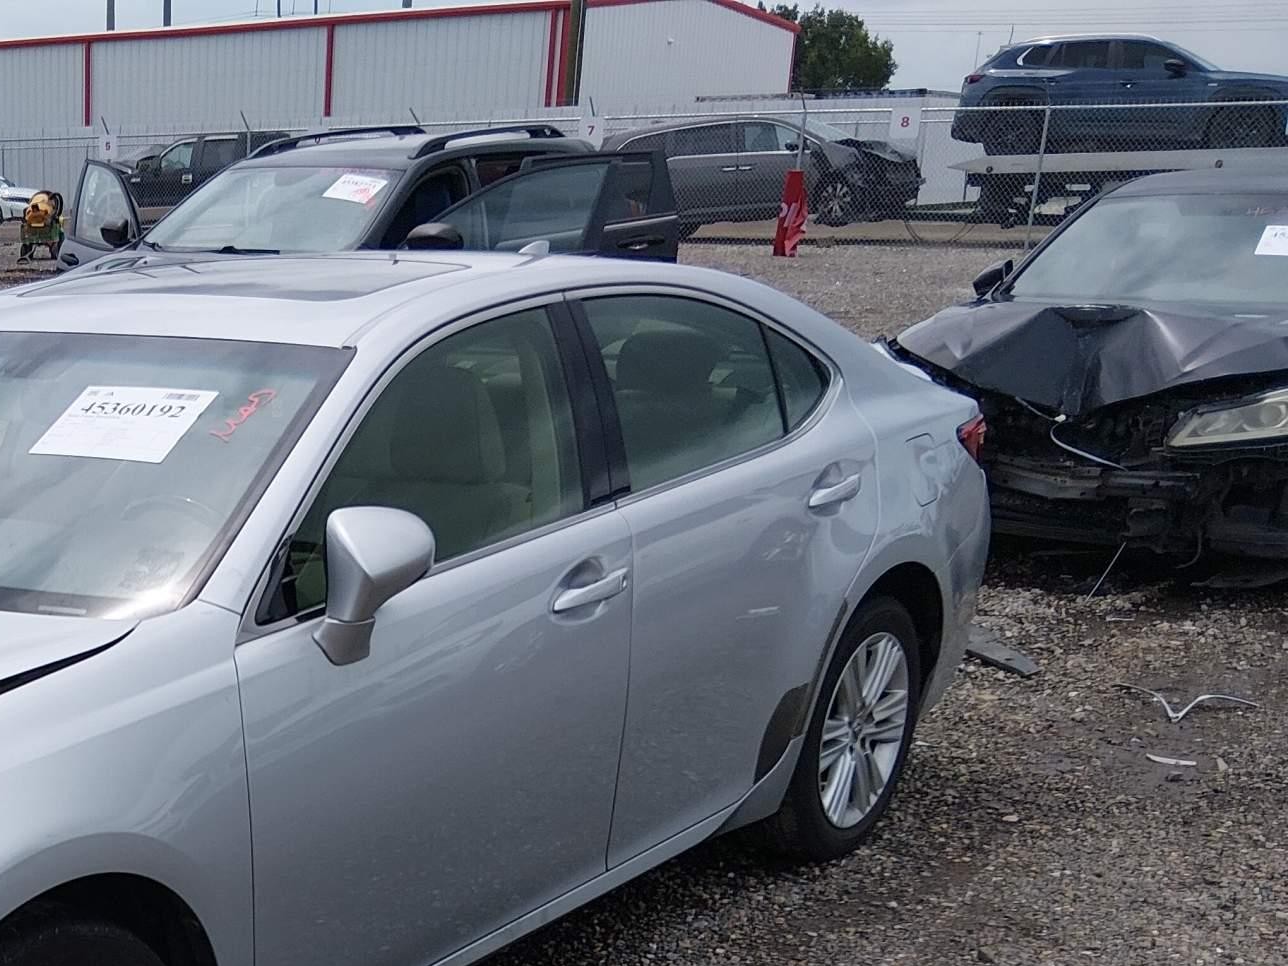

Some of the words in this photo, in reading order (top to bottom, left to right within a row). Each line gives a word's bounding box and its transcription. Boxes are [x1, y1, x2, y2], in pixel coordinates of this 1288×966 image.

[901, 116, 910, 128] 8
[587, 125, 595, 136] 7
[80, 401, 187, 418] 45360192
